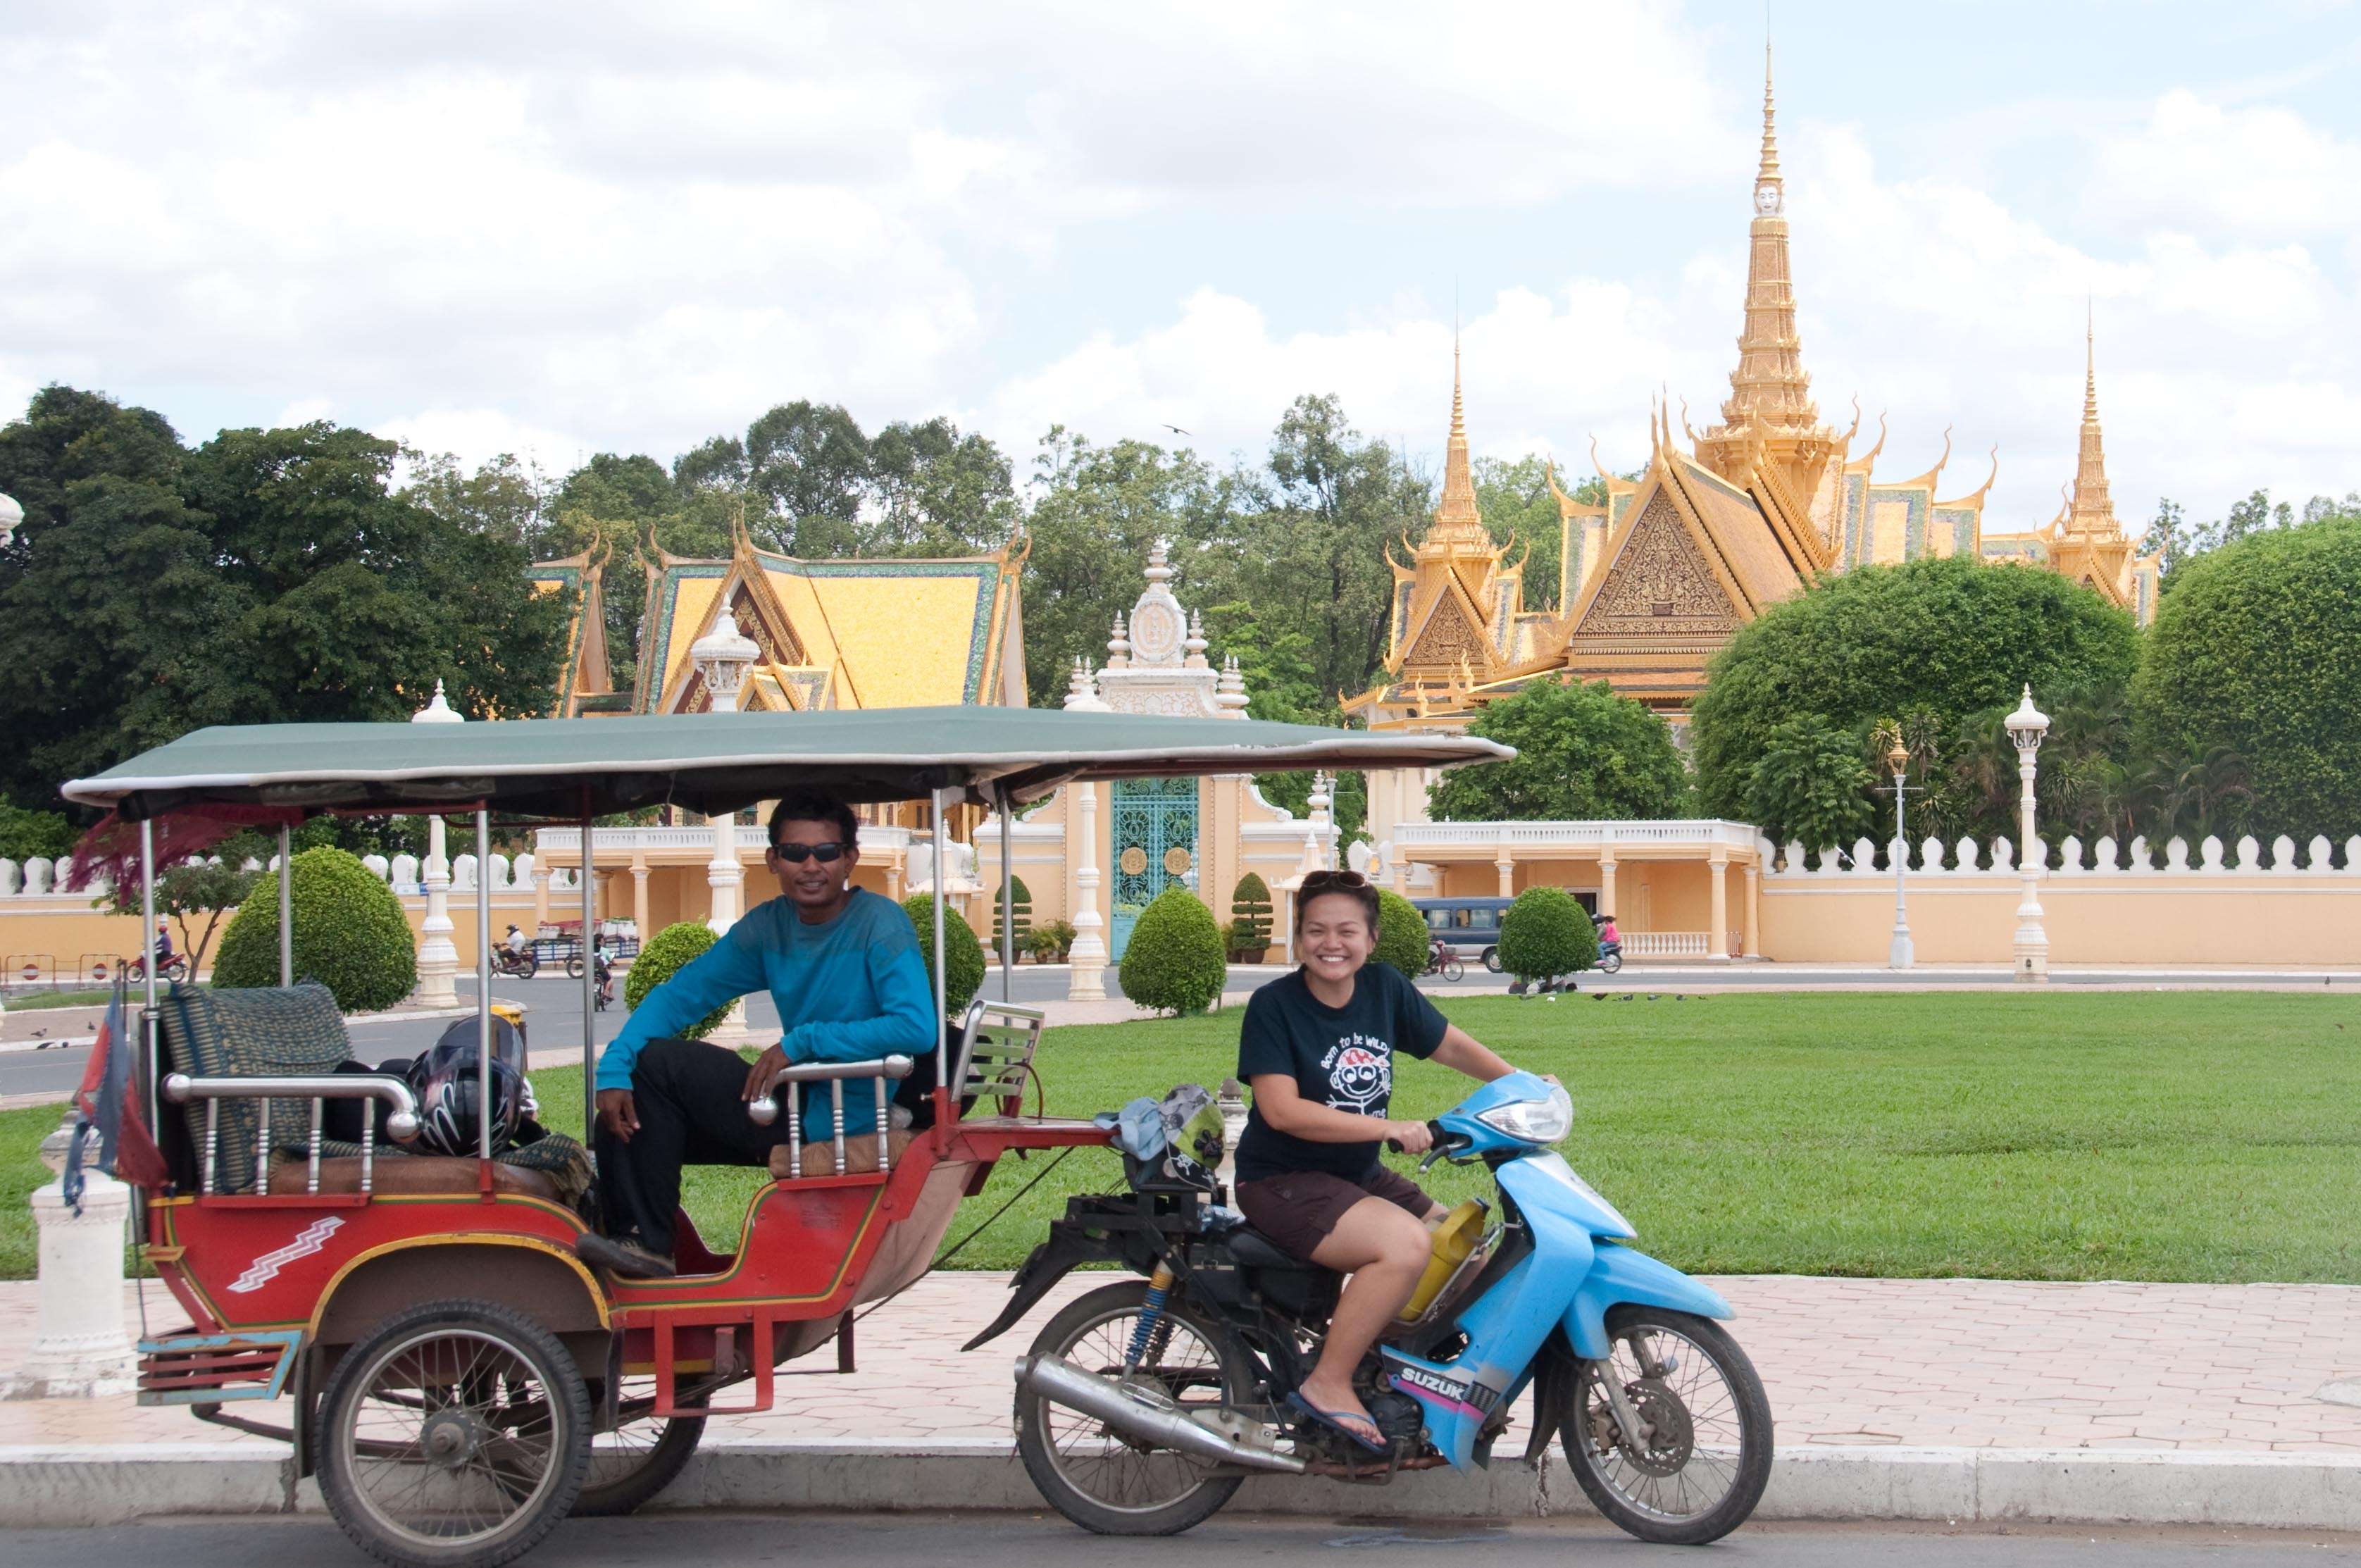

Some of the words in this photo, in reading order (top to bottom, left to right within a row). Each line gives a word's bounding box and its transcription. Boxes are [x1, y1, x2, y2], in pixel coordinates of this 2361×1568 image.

[1339, 1036, 1351, 1049] to
[1353, 1032, 1363, 1045] be
[1401, 1367, 1466, 1400] SUZUK
